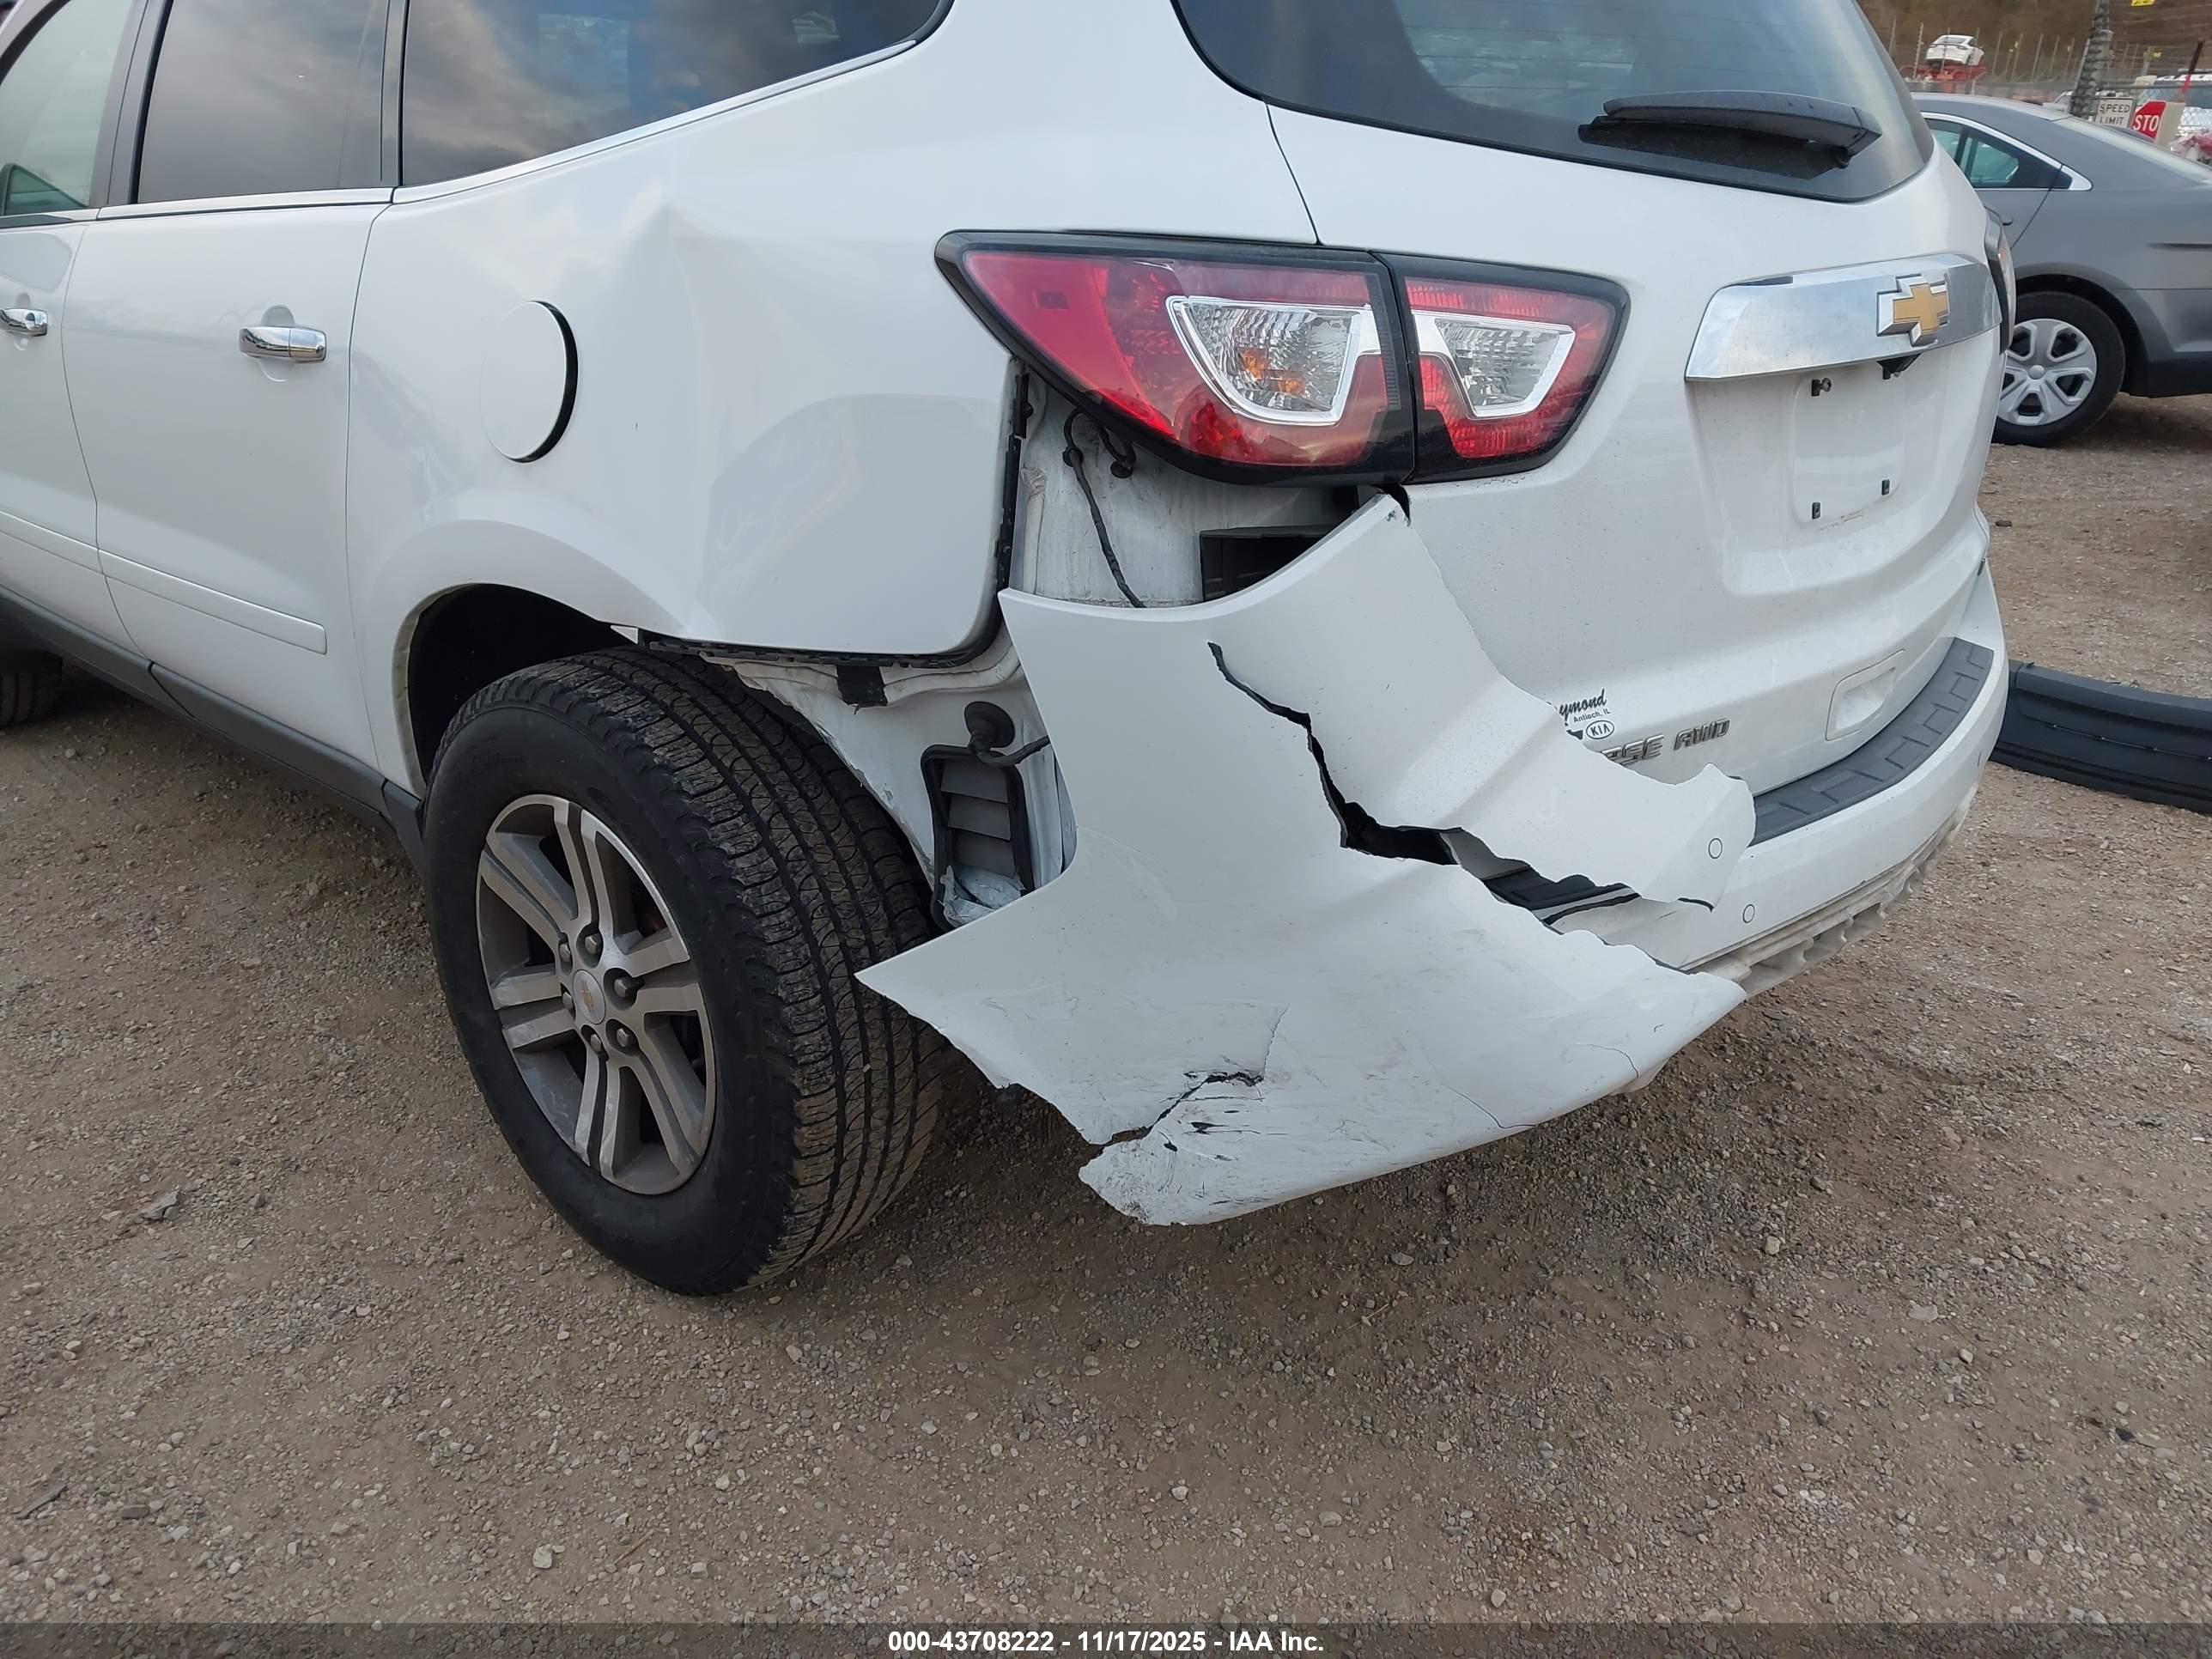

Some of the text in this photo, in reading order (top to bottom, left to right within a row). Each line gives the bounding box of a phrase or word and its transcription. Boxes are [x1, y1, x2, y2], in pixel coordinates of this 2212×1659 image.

[2099, 103, 2130, 113] SPEED
[2099, 115, 2124, 125] LIMIT
[2132, 114, 2160, 131] STO
[1553, 688, 1607, 726] ymond
[1590, 723, 1611, 737] KIA
[1674, 718, 1731, 751] AWD
